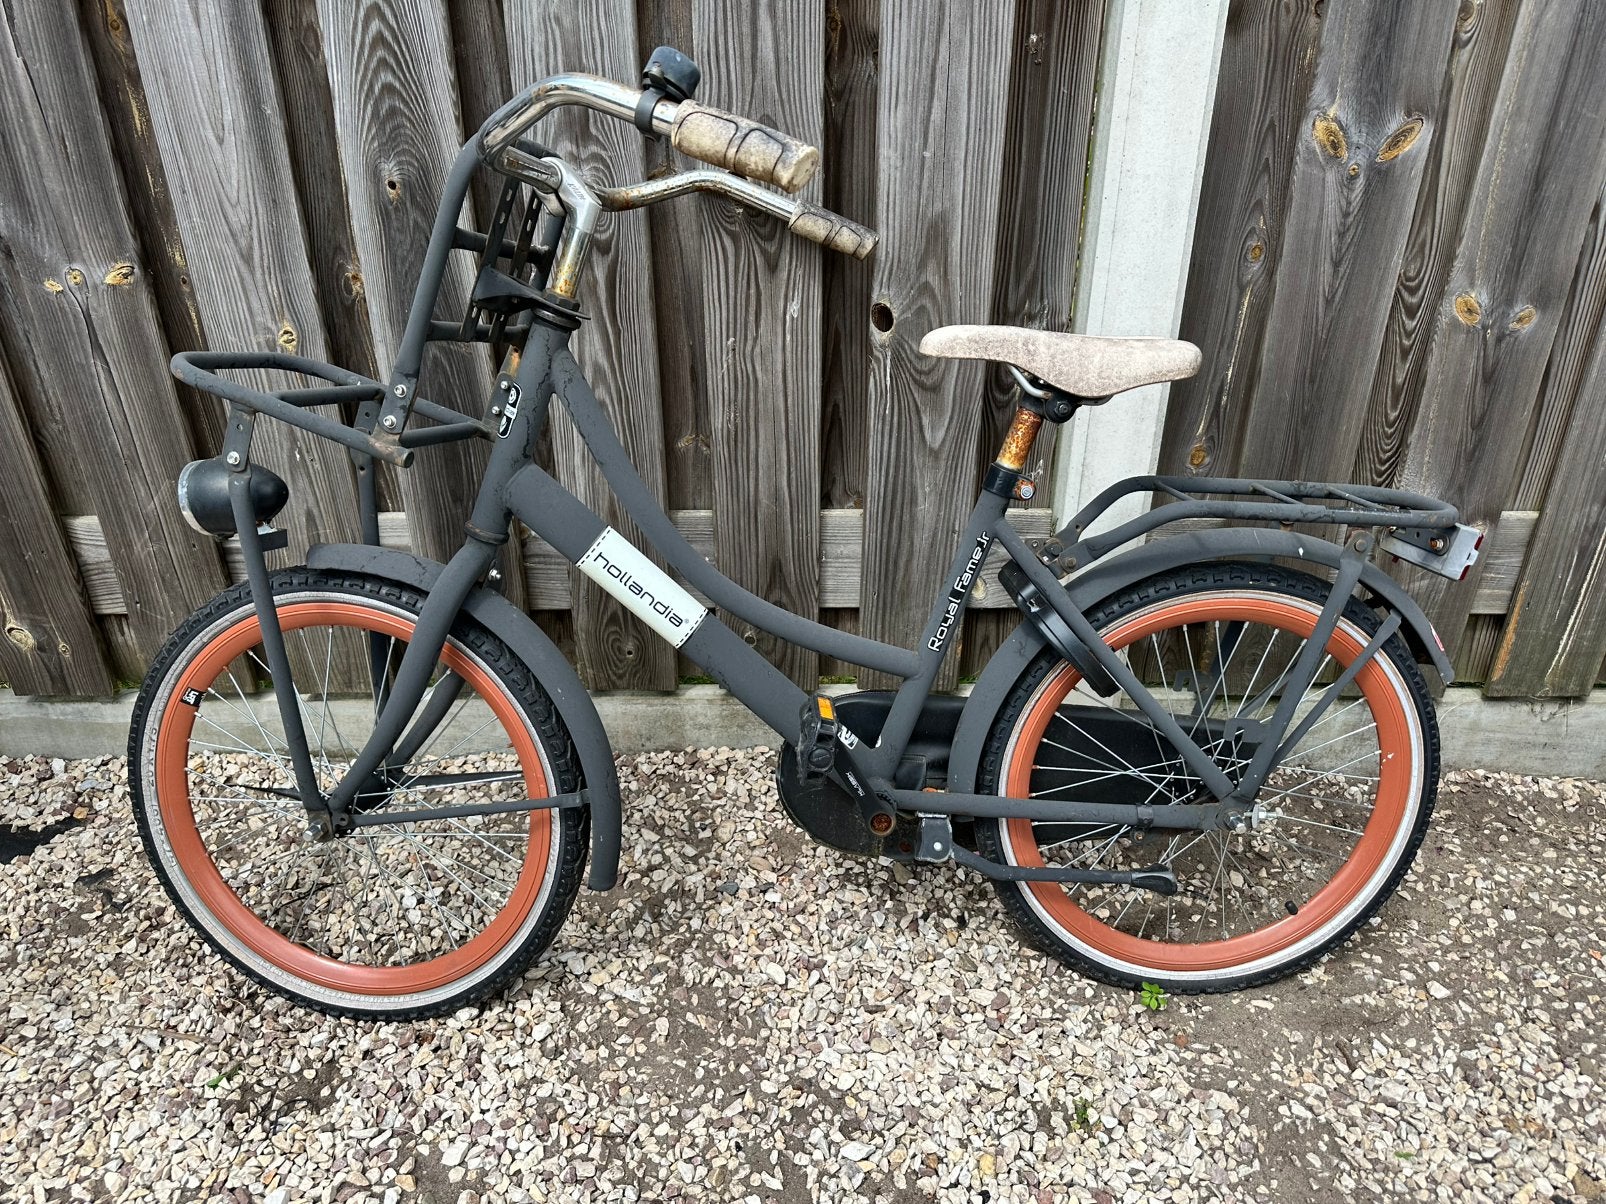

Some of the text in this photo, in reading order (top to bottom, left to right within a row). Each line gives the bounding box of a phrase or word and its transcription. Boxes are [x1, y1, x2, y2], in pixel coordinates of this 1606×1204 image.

[593, 551, 684, 628] hollandia
[927, 531, 990, 652] Royal Fame Jr
